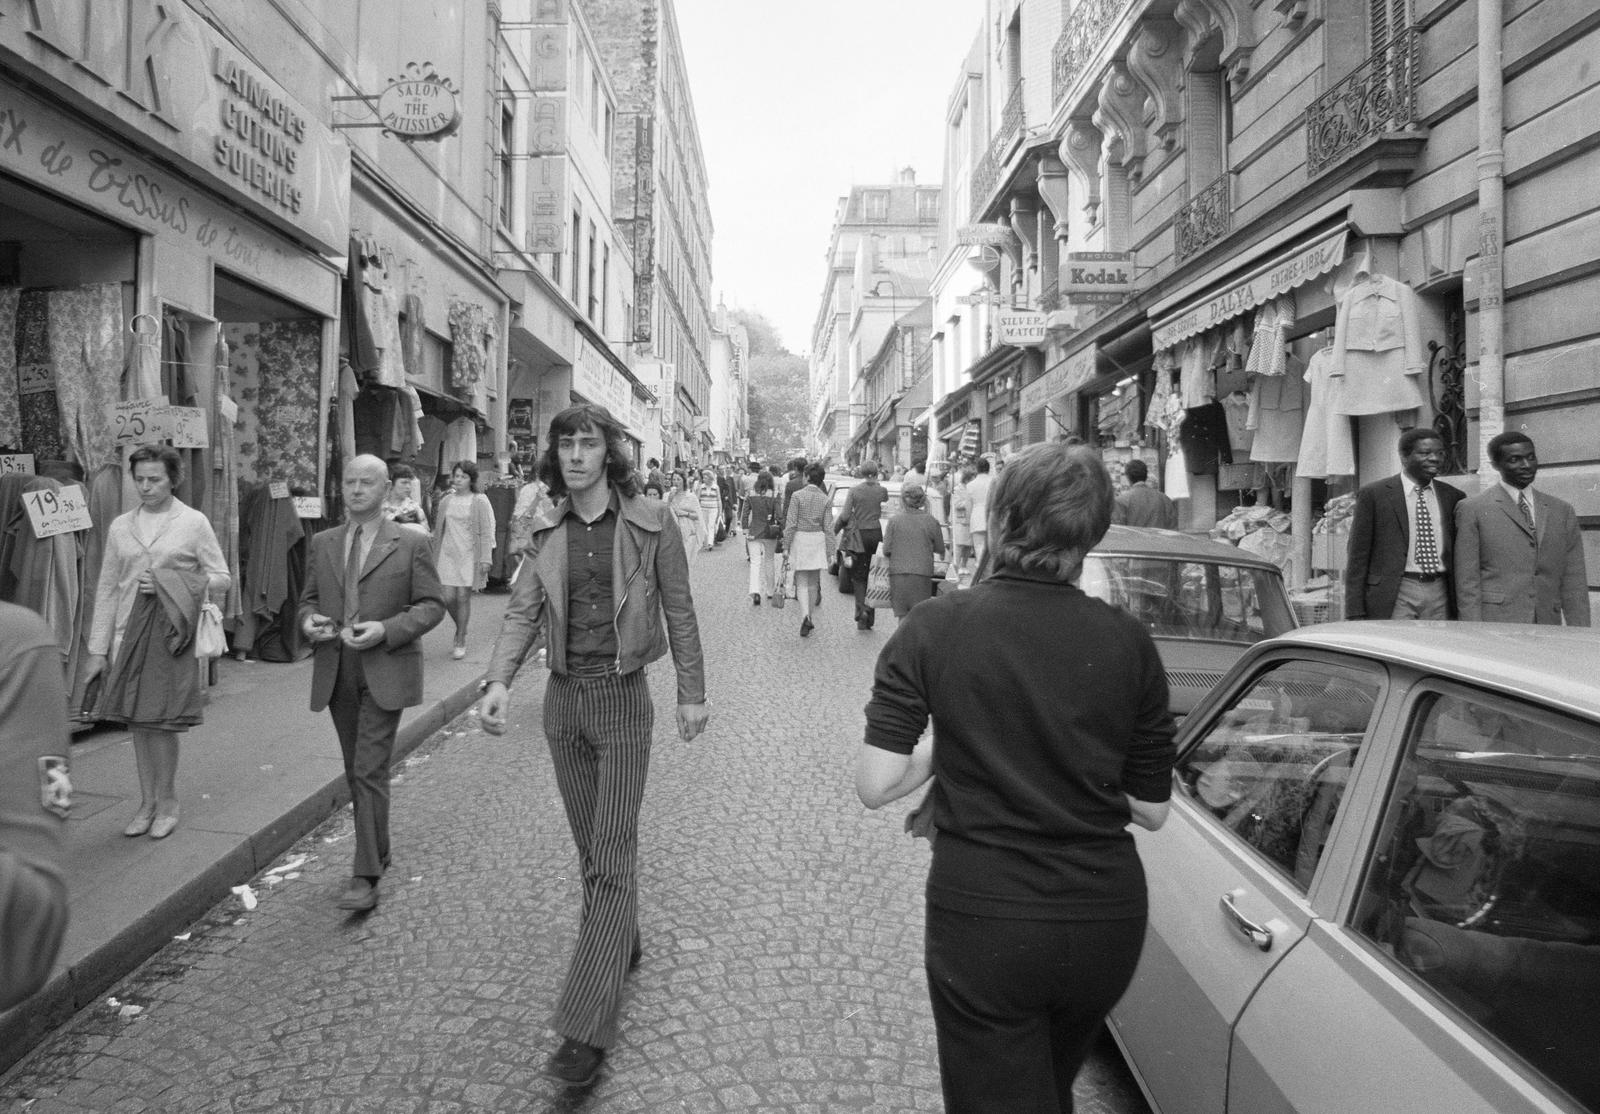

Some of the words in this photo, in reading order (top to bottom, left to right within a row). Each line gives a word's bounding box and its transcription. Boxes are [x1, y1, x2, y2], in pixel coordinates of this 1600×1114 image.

[212, 47, 306, 145] LAINAGES
[397, 84, 439, 97] SALON
[384, 112, 449, 132] PATISSIER
[404, 103, 428, 115] THE
[219, 99, 297, 174] COTONS
[532, 33, 562, 248] GLACIER
[214, 135, 302, 214] SOIERIES
[40, 140, 73, 176] de
[196, 218, 217, 248] de
[1071, 268, 1128, 284] Kodak
[1210, 282, 1254, 320] DALYA
[1005, 327, 1045, 337] MATCH
[115, 412, 145, 440] 25
